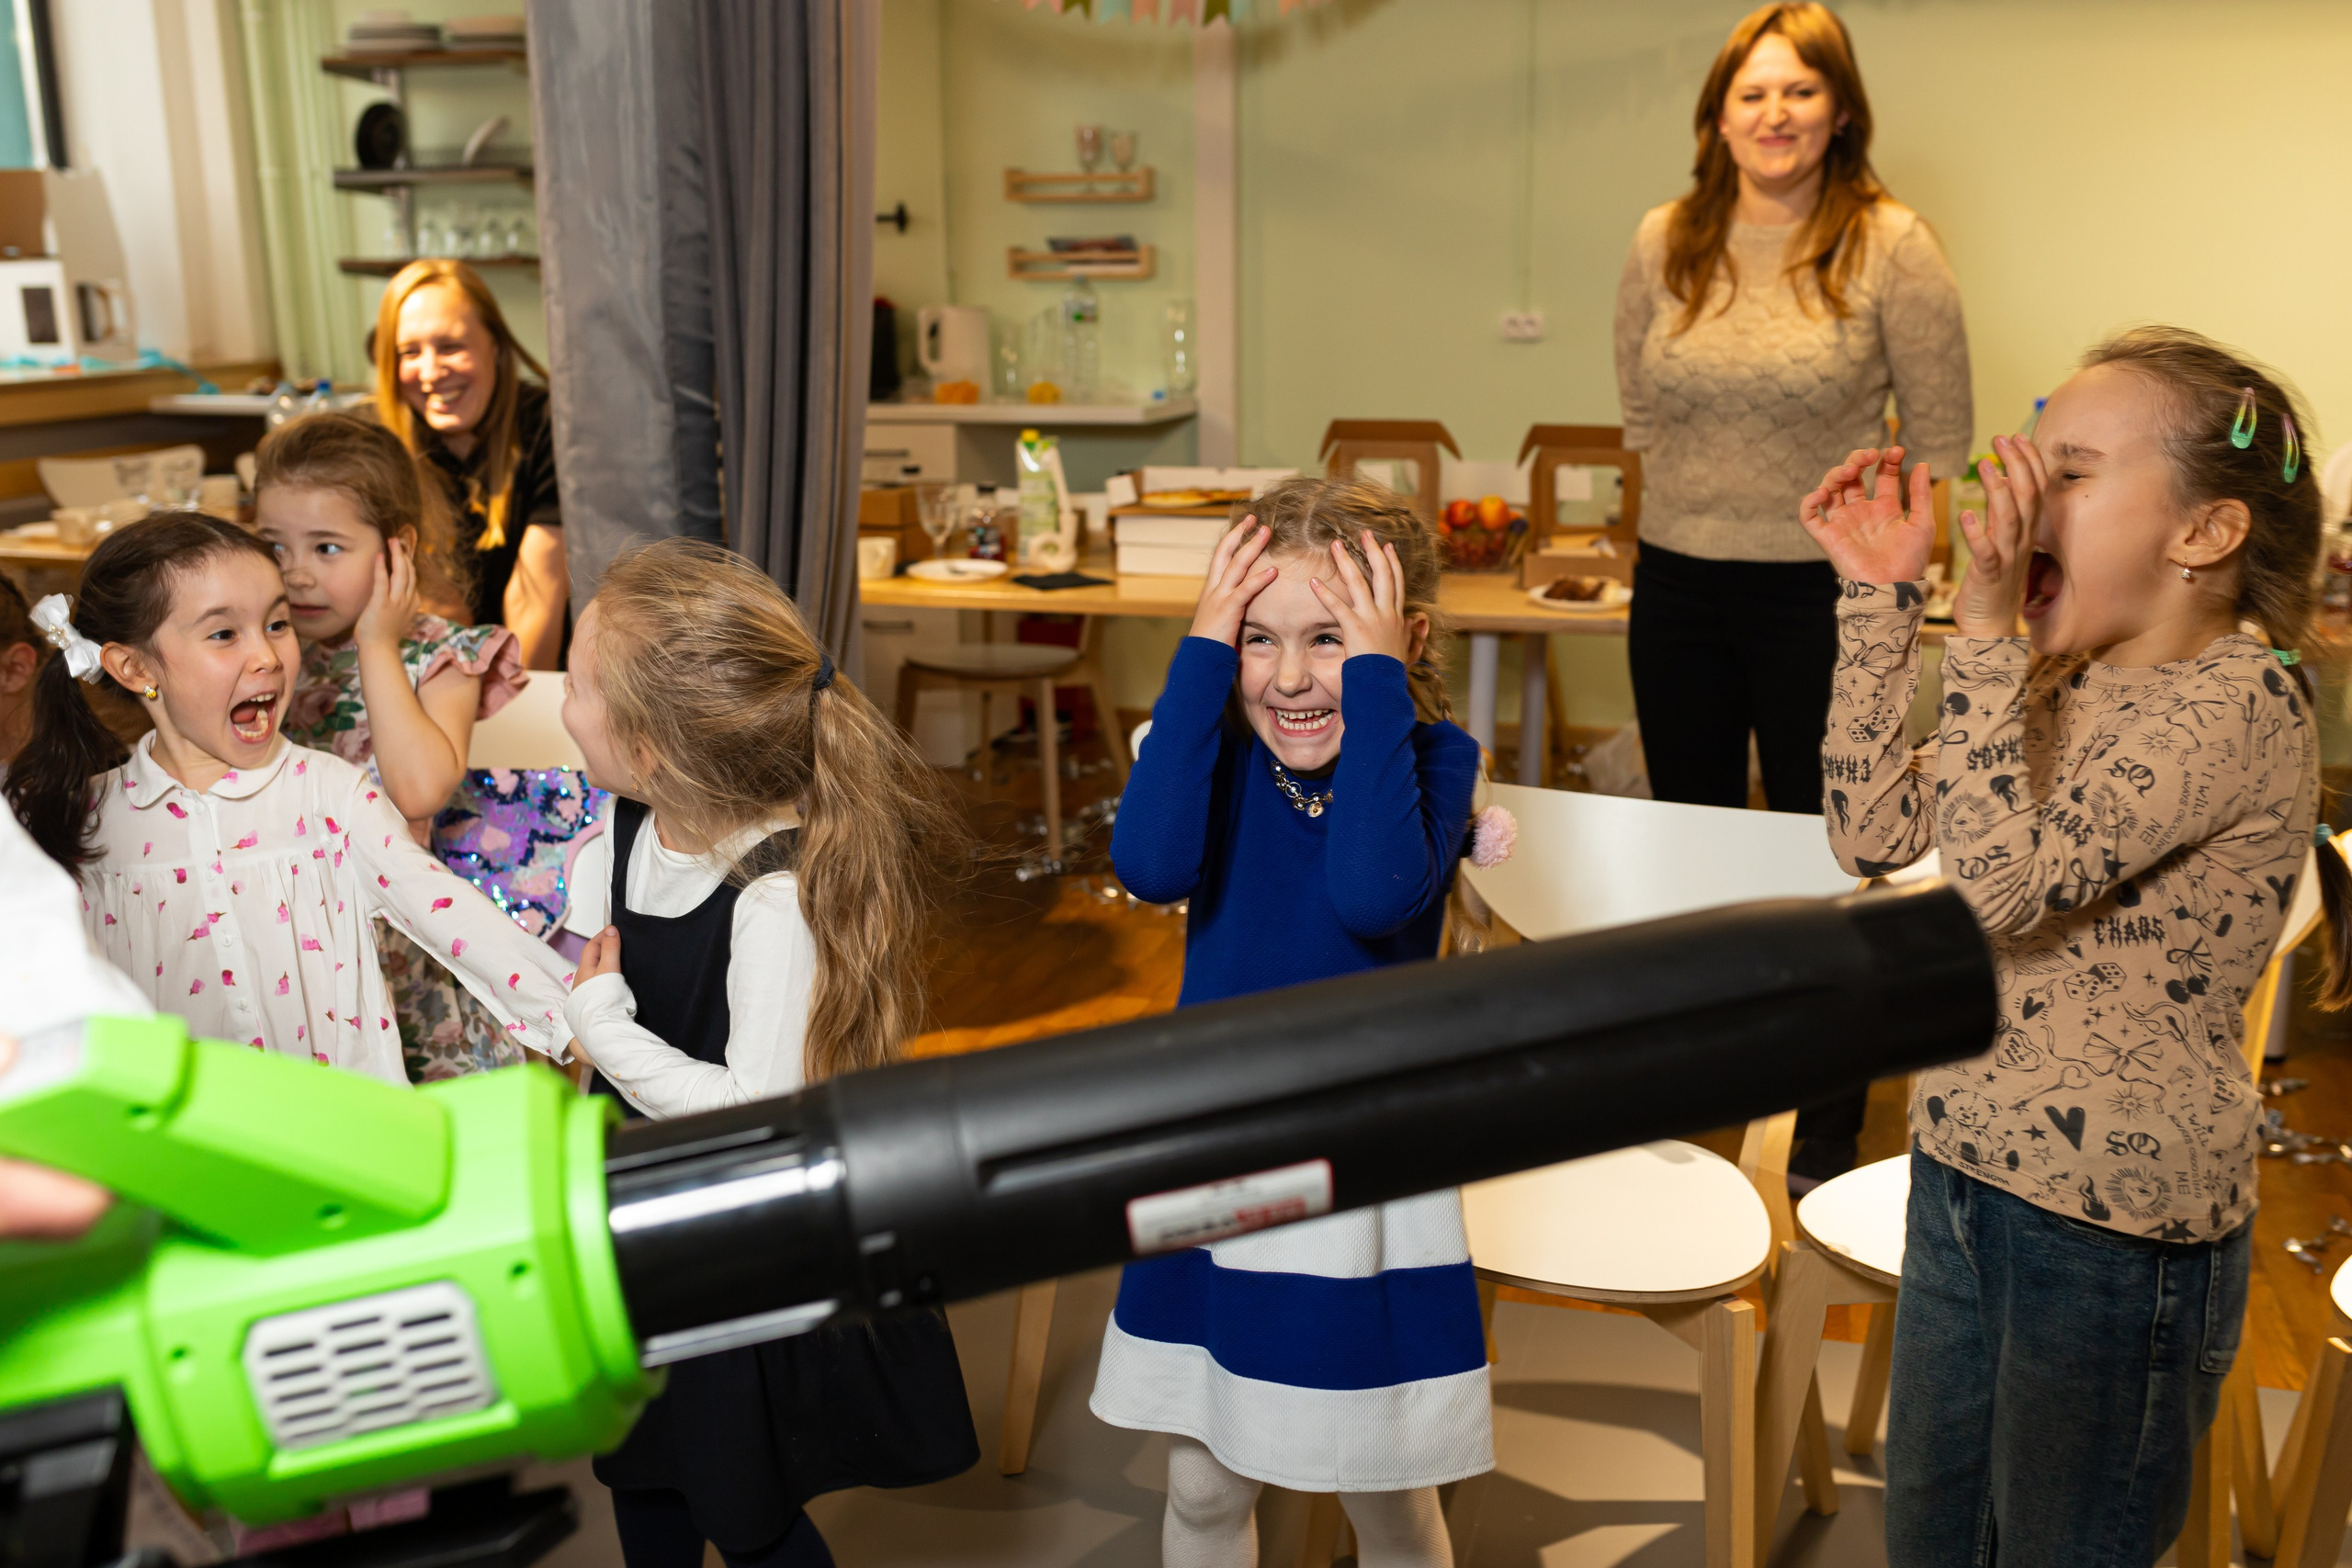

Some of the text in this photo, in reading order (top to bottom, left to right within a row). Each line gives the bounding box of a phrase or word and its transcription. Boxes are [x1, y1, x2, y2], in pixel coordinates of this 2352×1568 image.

[1966, 734, 2025, 773] HAOS
[2103, 757, 2155, 798] SQ
[2179, 770, 2193, 806] ALWAYS
[2140, 818, 2163, 845] ME
[2151, 808, 2186, 854] CHOOSING
[2093, 915, 2165, 950] CHAOS
[1933, 1143, 2011, 1186] YOUR STRENGTH
[2104, 1131, 2162, 1161] SQ
[2175, 1171, 2191, 1195] ME
[2188, 1146, 2203, 1199] CHOOSING
